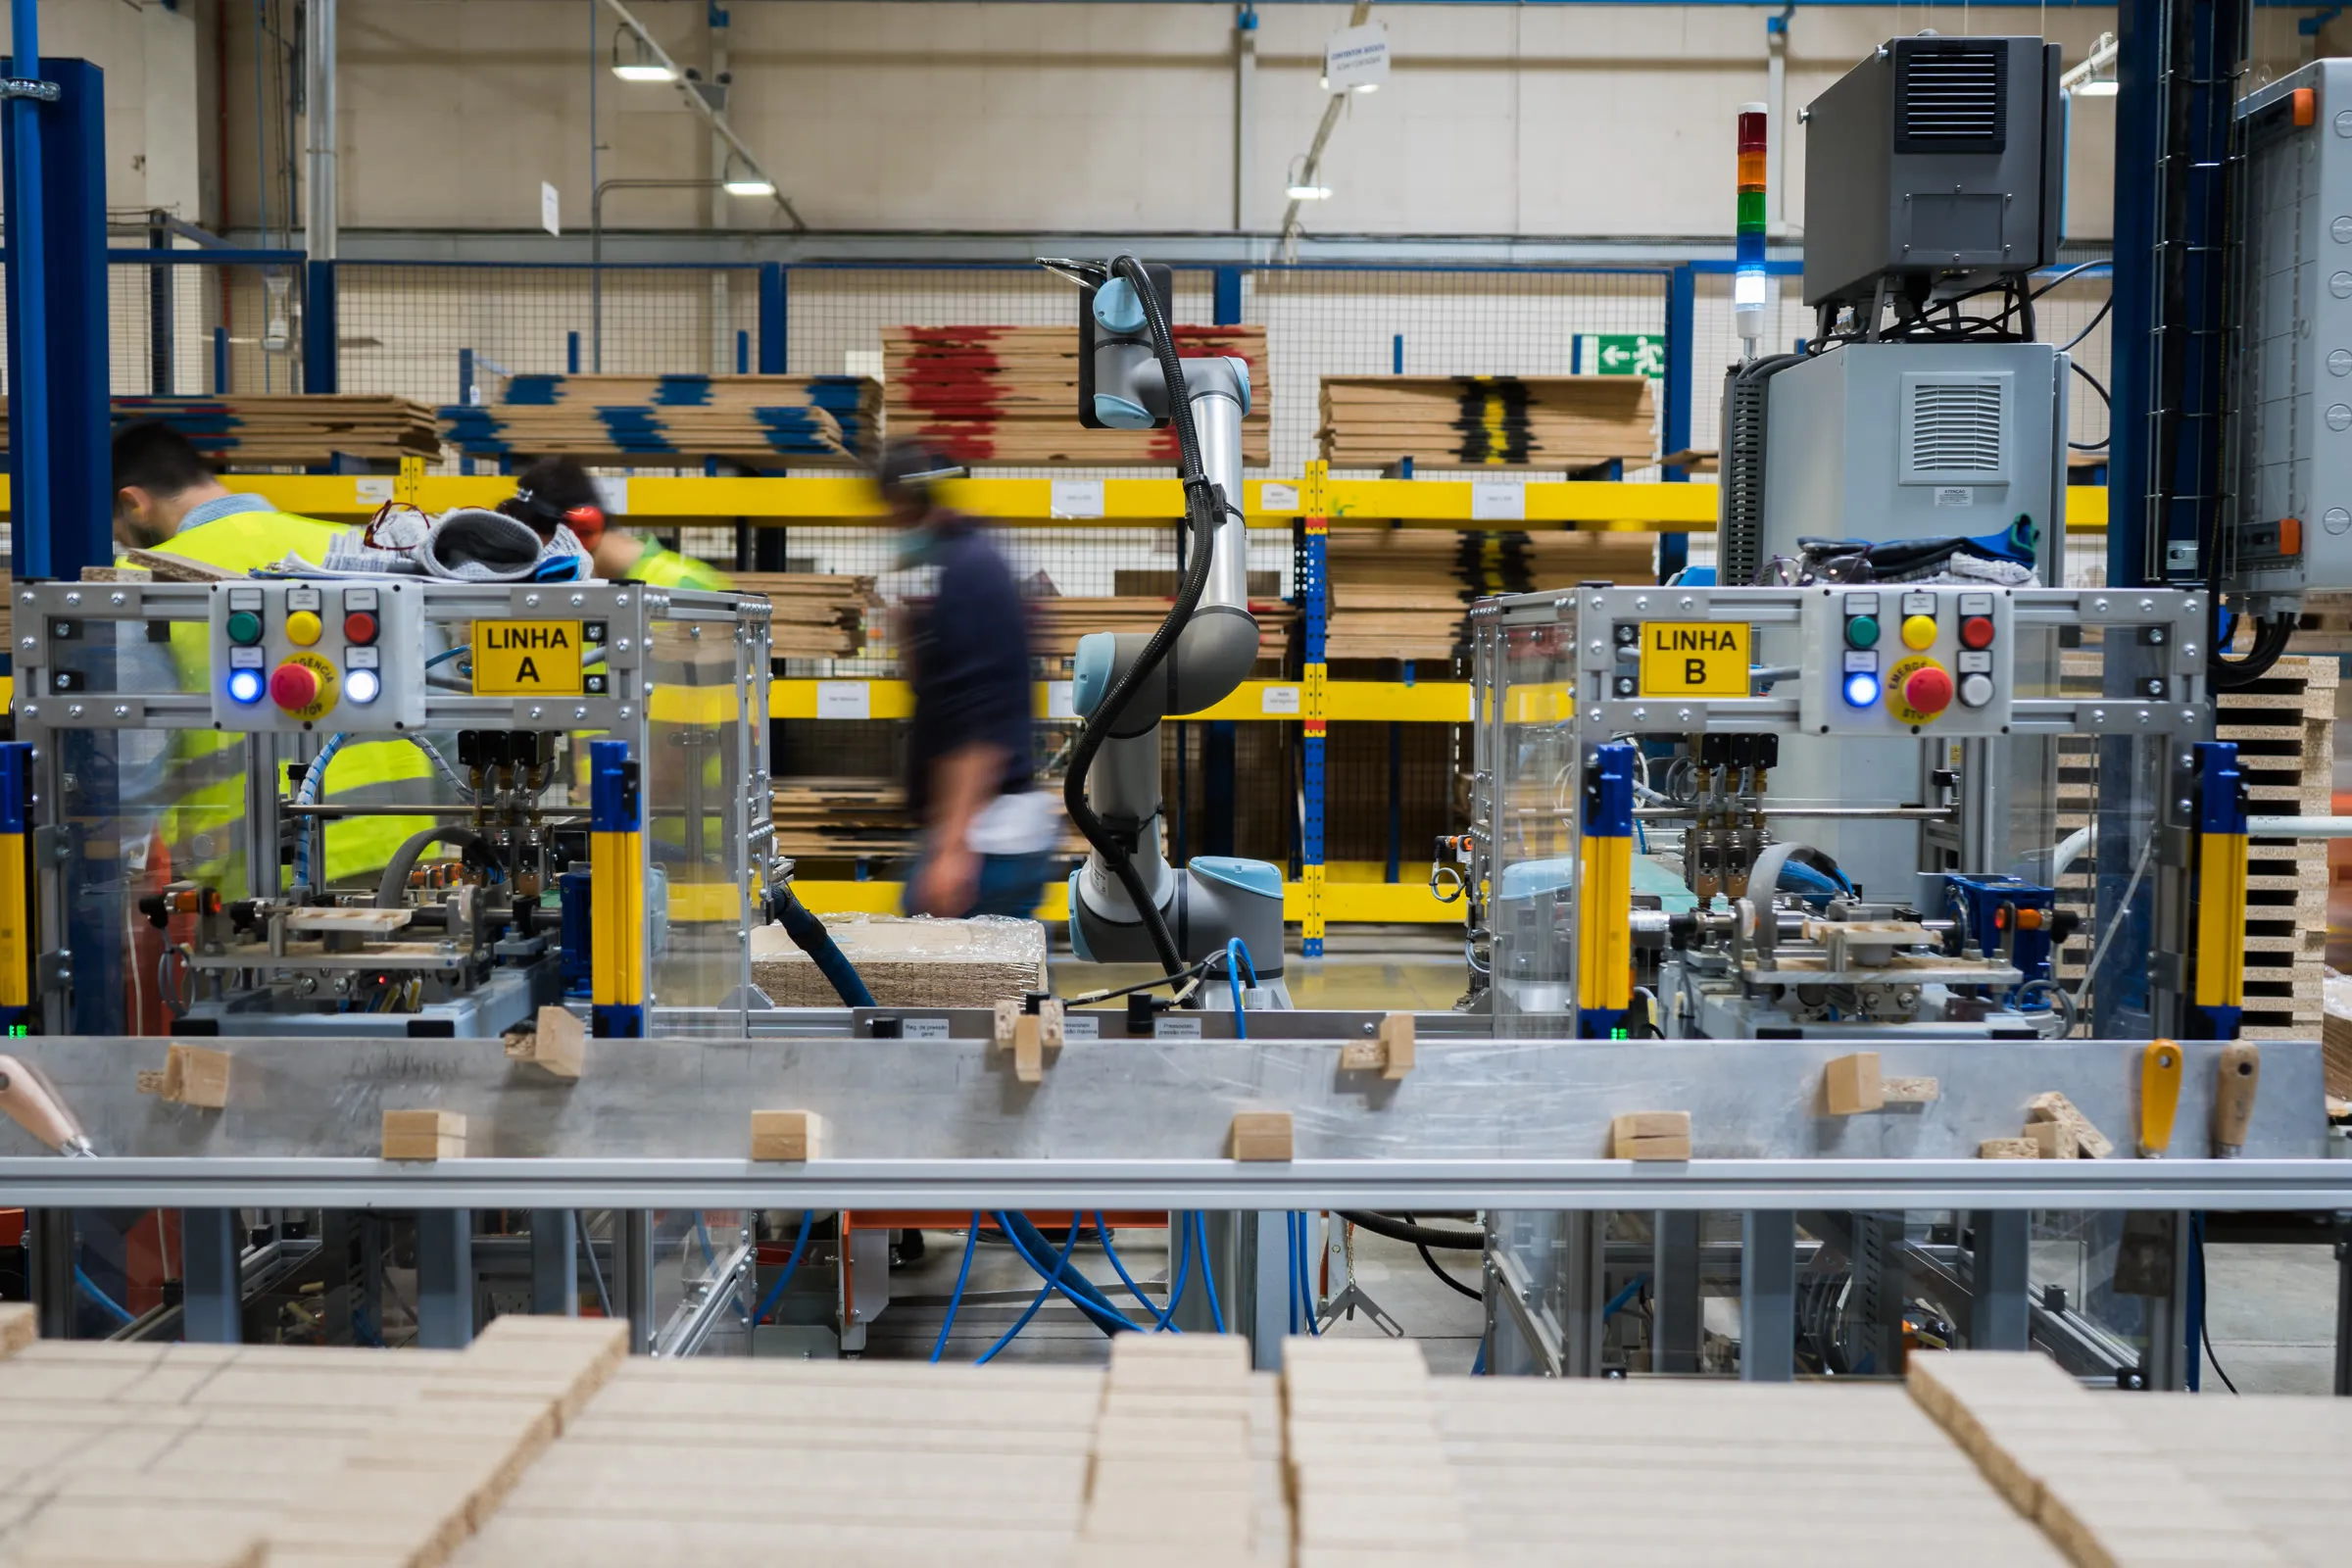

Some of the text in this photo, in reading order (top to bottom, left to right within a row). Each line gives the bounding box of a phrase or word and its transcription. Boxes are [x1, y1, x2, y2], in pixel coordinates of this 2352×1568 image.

[487, 628, 568, 649] LINHA
[1656, 630, 1737, 651] LINHA
[515, 656, 540, 682] A
[1686, 659, 1706, 684] B
